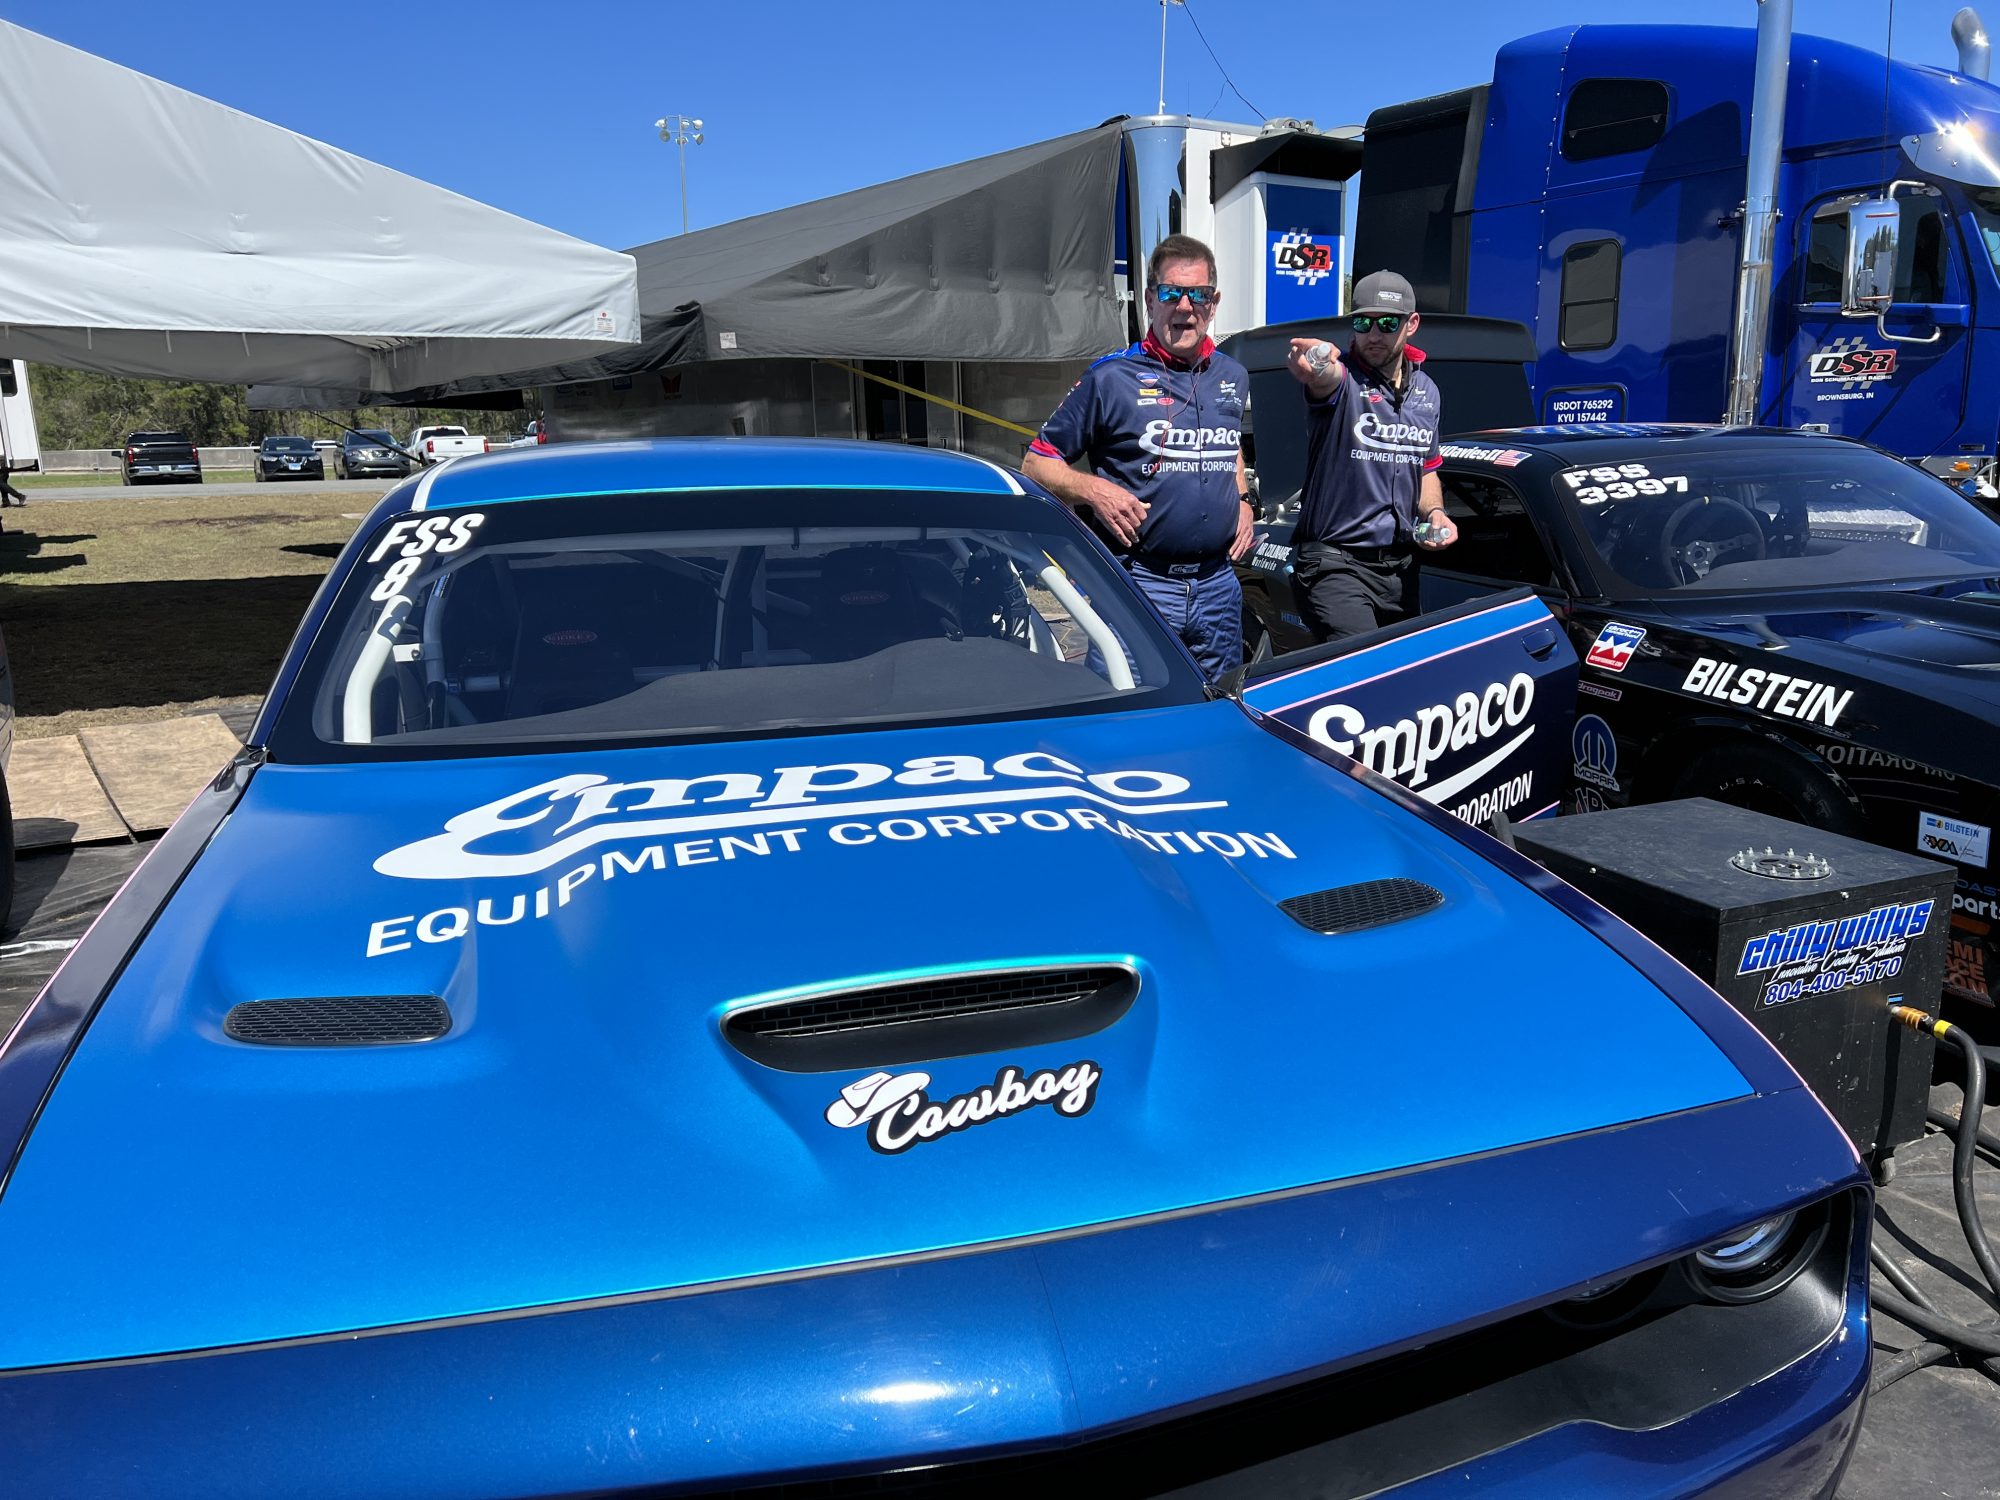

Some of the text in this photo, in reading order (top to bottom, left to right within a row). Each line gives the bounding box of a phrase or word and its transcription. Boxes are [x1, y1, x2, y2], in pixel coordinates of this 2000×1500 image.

[1278, 244, 1328, 270] DSR
[1815, 350, 1893, 376] DSR
[1553, 399, 1613, 411] USDOT 765292
[1817, 391, 1875, 401] BROWNSBURG, IN
[1353, 412, 1434, 451] Empaco
[1557, 412, 1607, 423] KYU 157442
[1562, 463, 1651, 489] FSS
[1575, 475, 1688, 505] 3397
[367, 513, 486, 563] FSS
[370, 556, 422, 601] 8
[1682, 657, 1854, 727] BILSTEIN
[1574, 763, 1616, 789] MOPAR
[372, 752, 1192, 880] Empaco
[1944, 821, 1981, 839] BILSTEIN
[366, 807, 1298, 958] EQUIPMENT CORPORATION
[1952, 893, 2000, 921] part
[1766, 935, 1907, 986] Innovative Cooling Solutions
[1764, 957, 1903, 1005] 804-400-5170
[872, 1061, 1101, 1153] Cowboy
